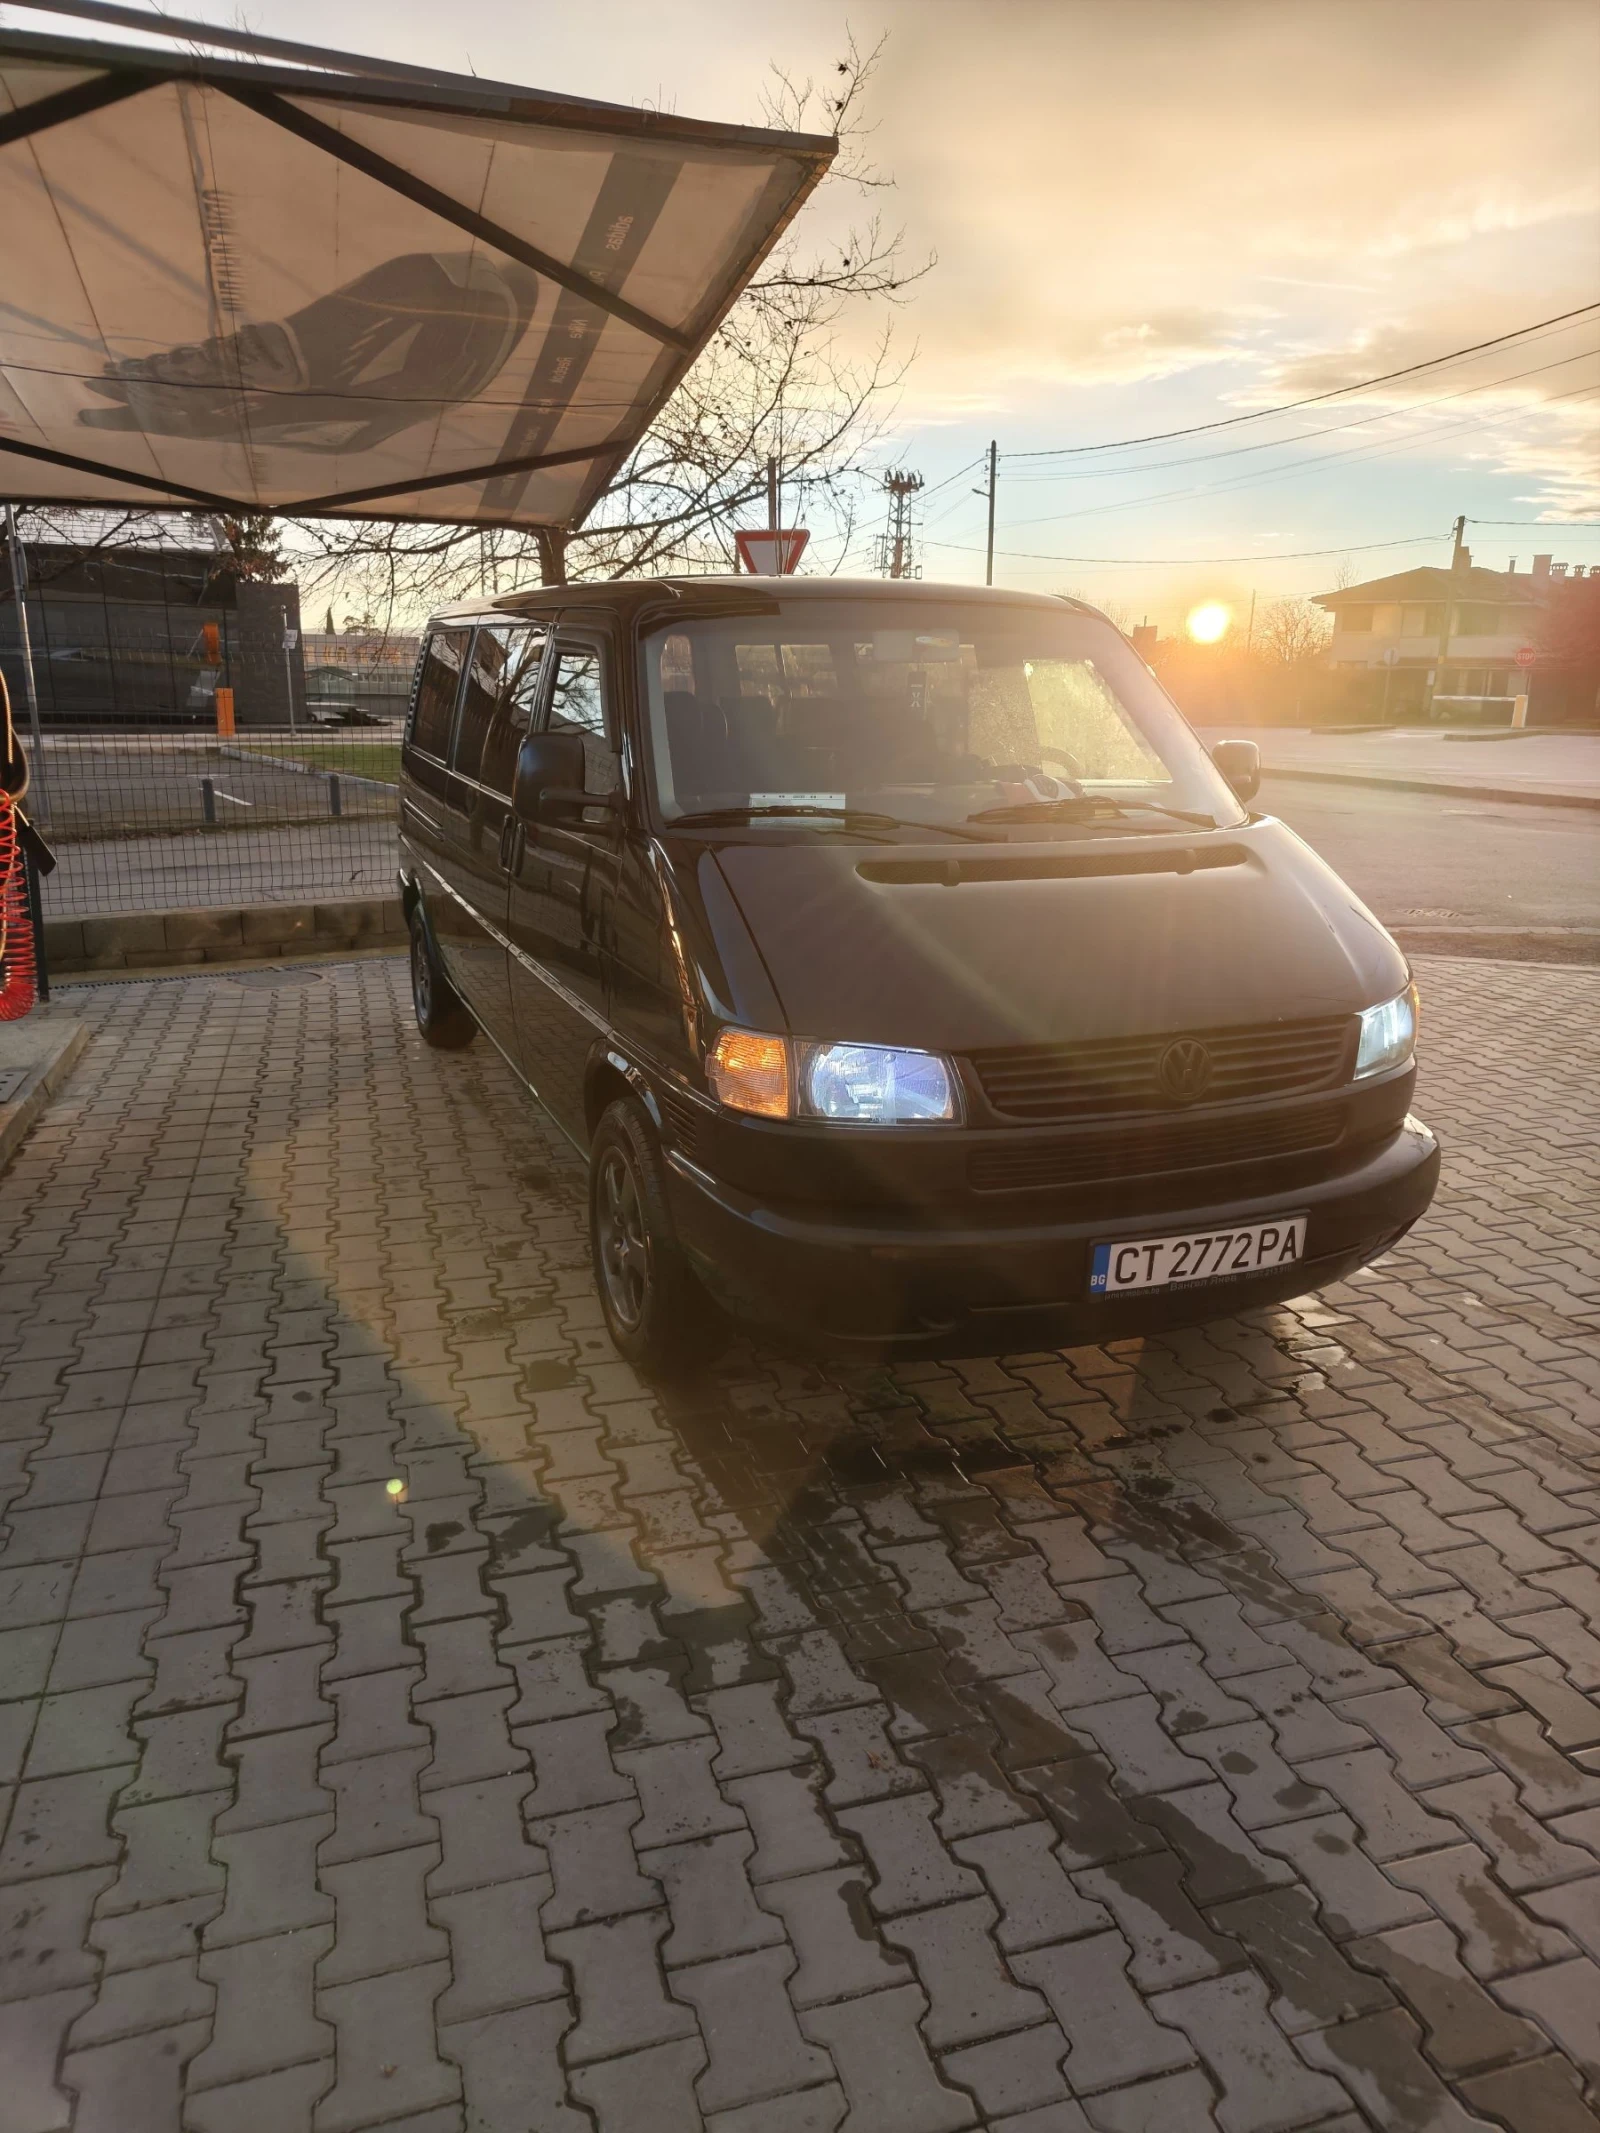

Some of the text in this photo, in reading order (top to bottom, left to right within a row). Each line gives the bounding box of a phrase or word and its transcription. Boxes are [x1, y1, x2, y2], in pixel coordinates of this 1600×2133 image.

[1115, 1225, 1297, 1284] CT 2772 PA
[1090, 1274, 1106, 1287] BG
